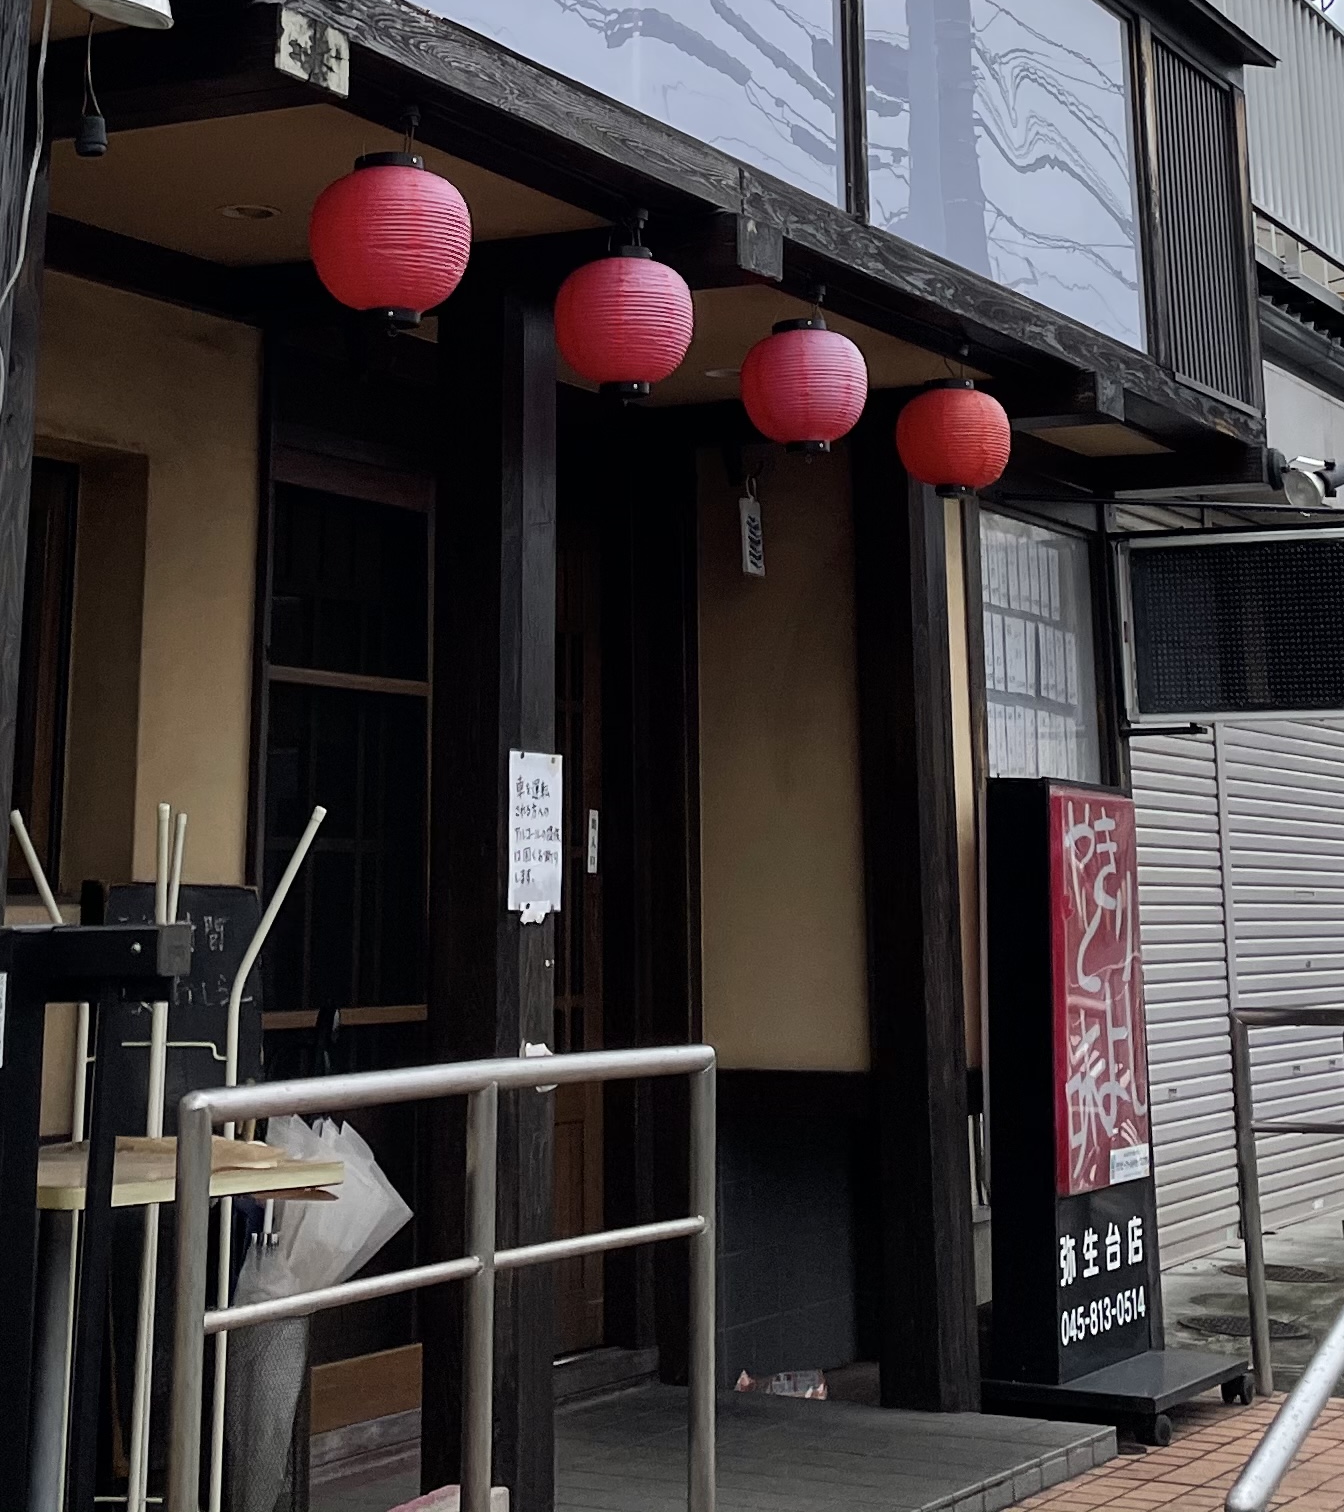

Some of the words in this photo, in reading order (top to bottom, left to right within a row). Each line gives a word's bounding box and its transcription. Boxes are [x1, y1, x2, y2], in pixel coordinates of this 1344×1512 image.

[1059, 1215, 1144, 1287] 弥生台店
[1060, 1285, 1146, 1347] 045-813-0514
